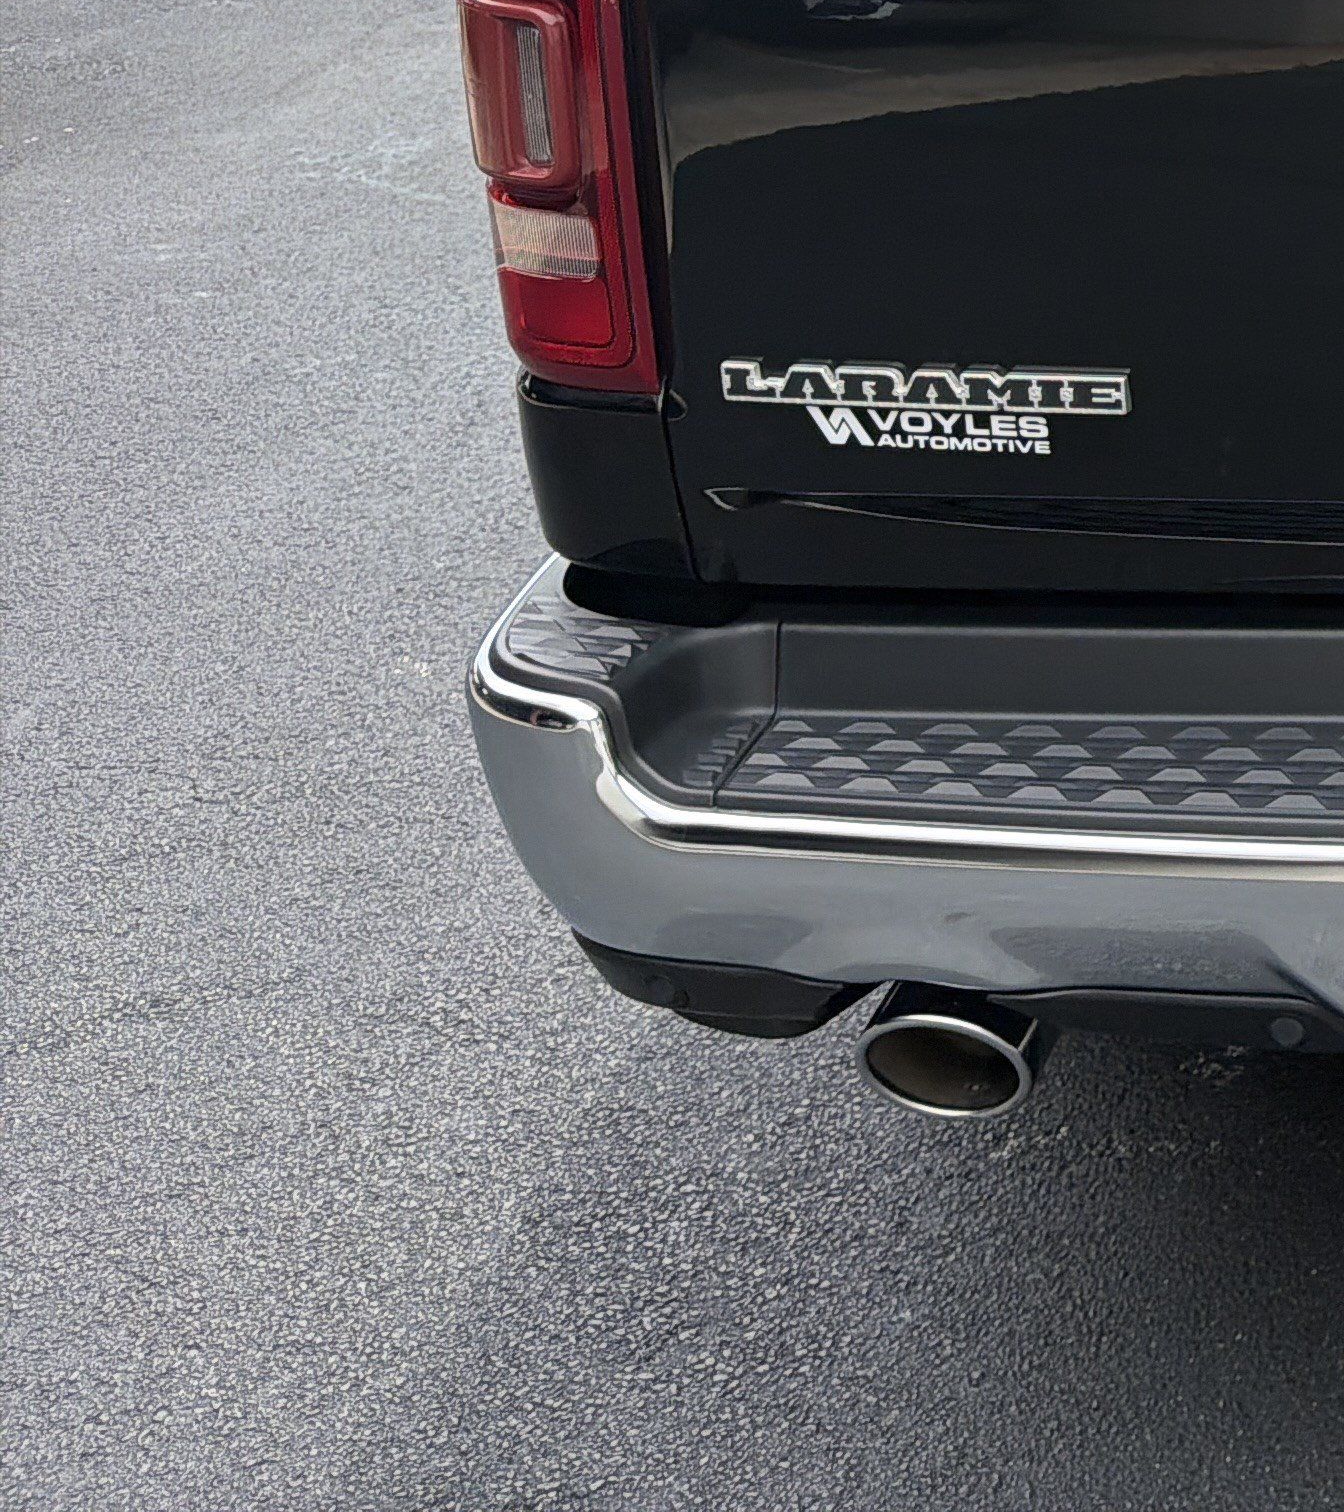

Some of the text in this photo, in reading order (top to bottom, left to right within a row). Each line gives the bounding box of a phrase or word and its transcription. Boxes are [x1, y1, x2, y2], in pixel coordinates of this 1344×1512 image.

[719, 356, 1131, 415] LARAMIE
[867, 408, 1050, 438] VOYLES
[874, 433, 1052, 455] AUTOMOTIVE
